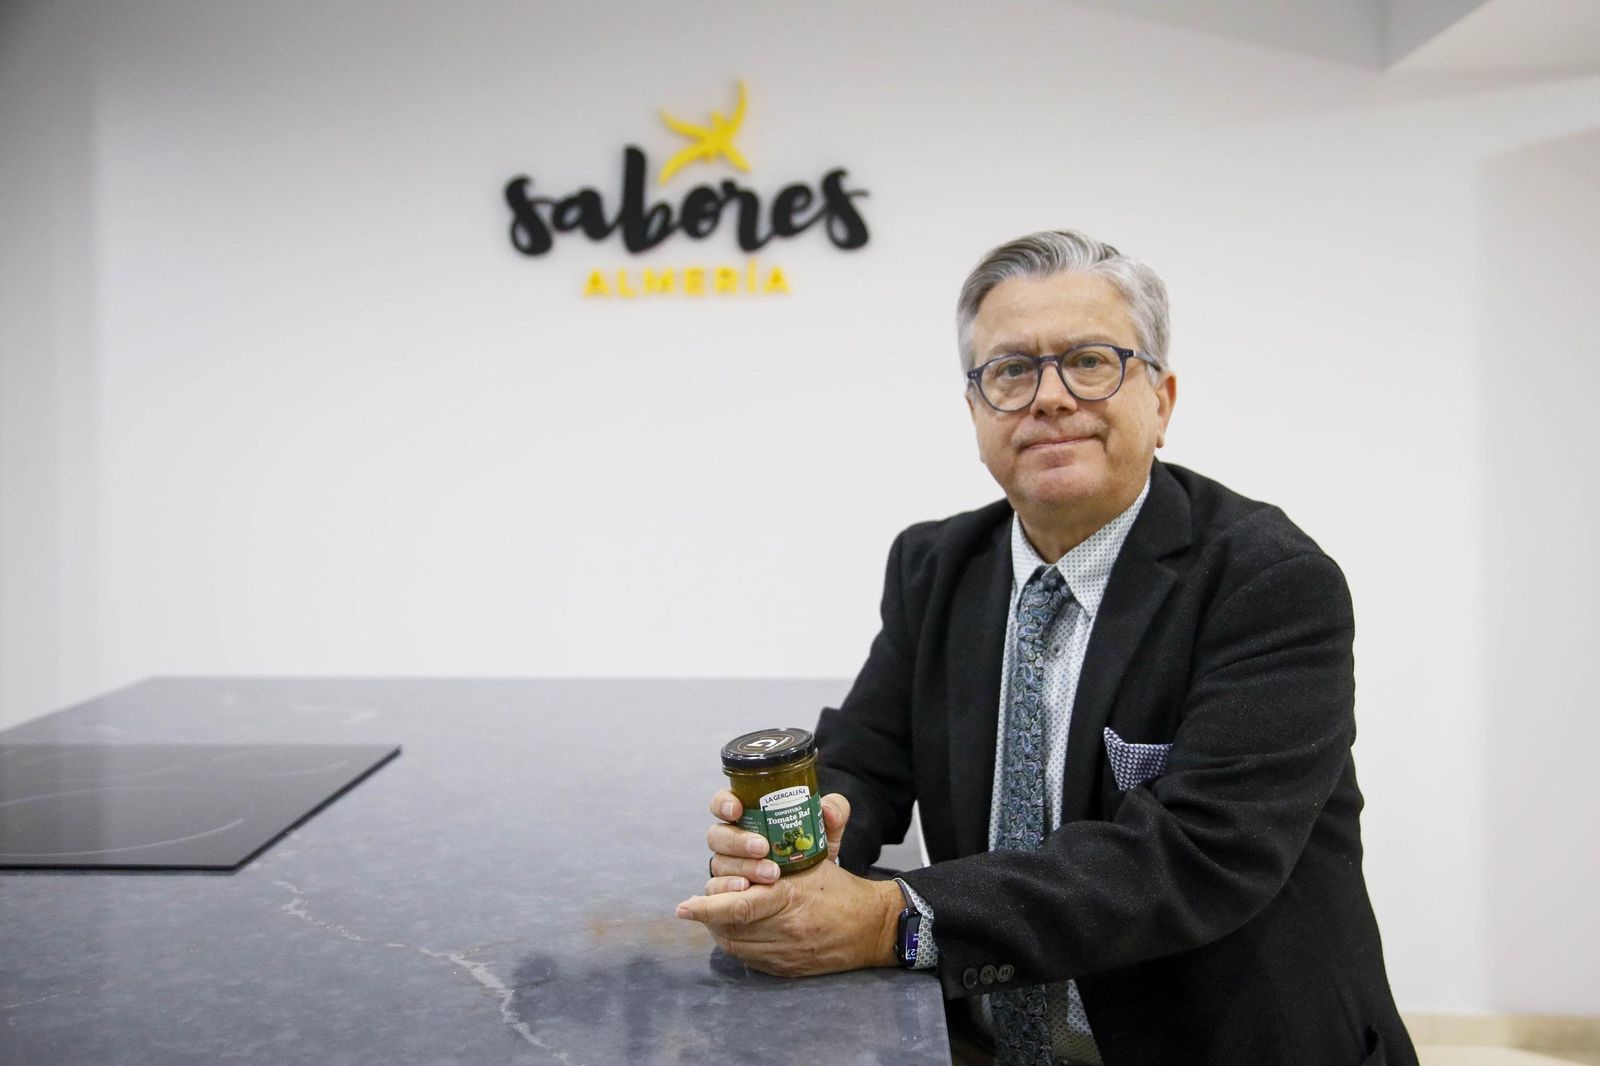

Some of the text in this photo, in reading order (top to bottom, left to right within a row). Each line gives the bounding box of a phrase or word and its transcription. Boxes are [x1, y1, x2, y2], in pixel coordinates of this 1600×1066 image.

[505, 143, 870, 256] sabores
[583, 257, 790, 298] ALMERÍA
[767, 814, 797, 825] Tomate
[799, 808, 811, 819] Raf
[780, 820, 802, 830] Verde
